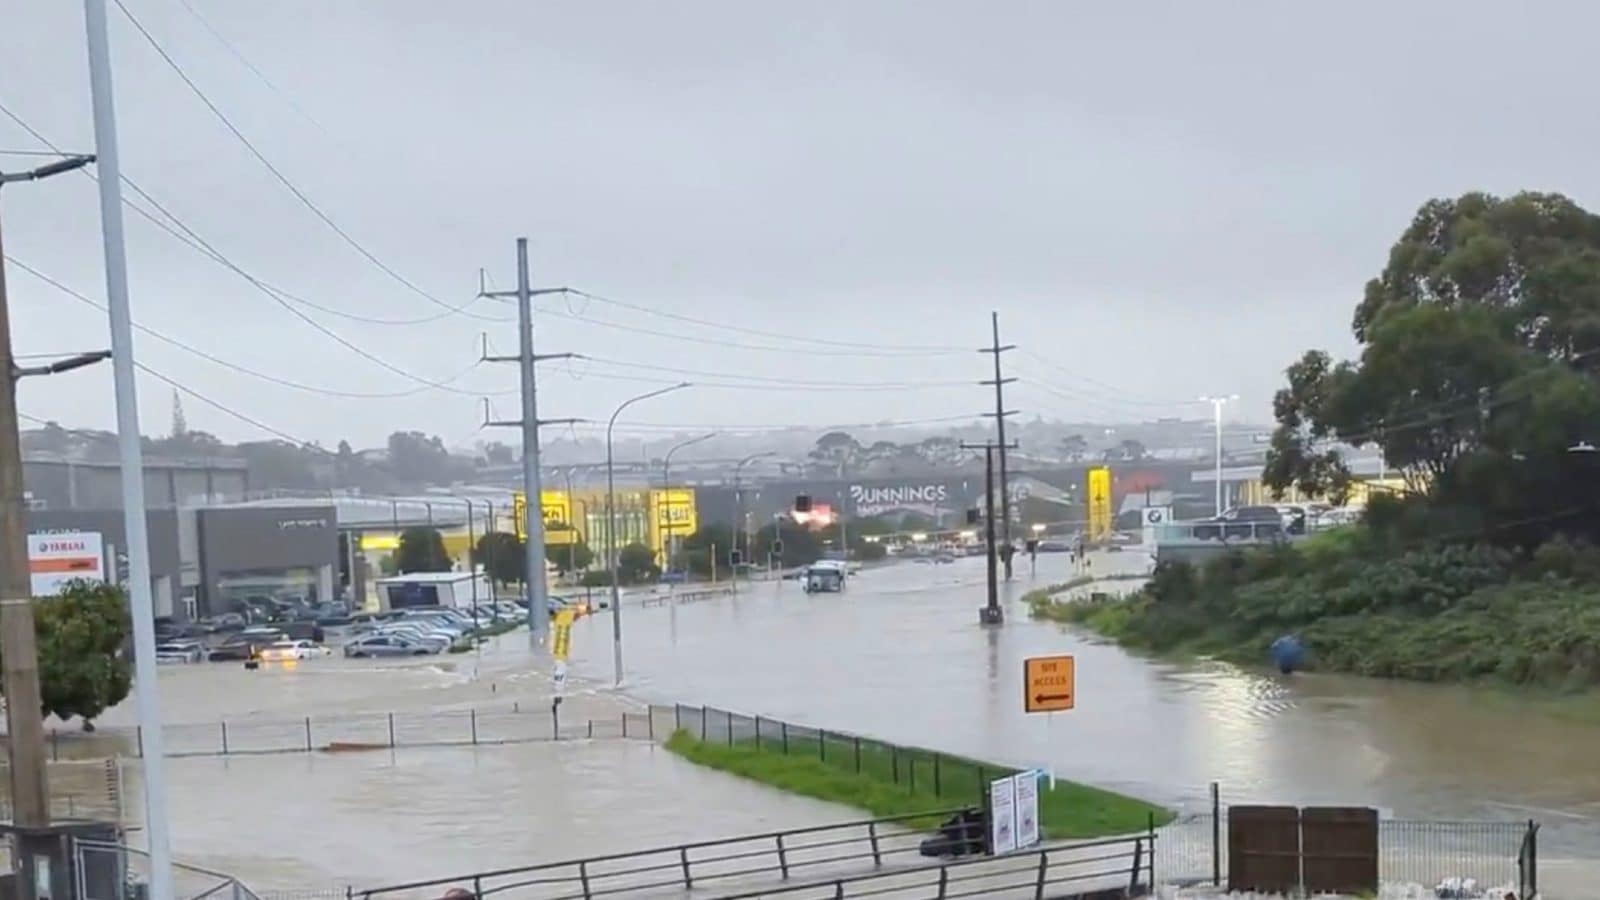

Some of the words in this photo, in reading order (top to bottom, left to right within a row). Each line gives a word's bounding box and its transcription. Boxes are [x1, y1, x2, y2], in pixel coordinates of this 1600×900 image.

[850, 485, 946, 503] BUNNINGS
[50, 542, 85, 552] YAMAHA
[1041, 662, 1058, 673] SITE
[1034, 676, 1067, 687] ACCESS
